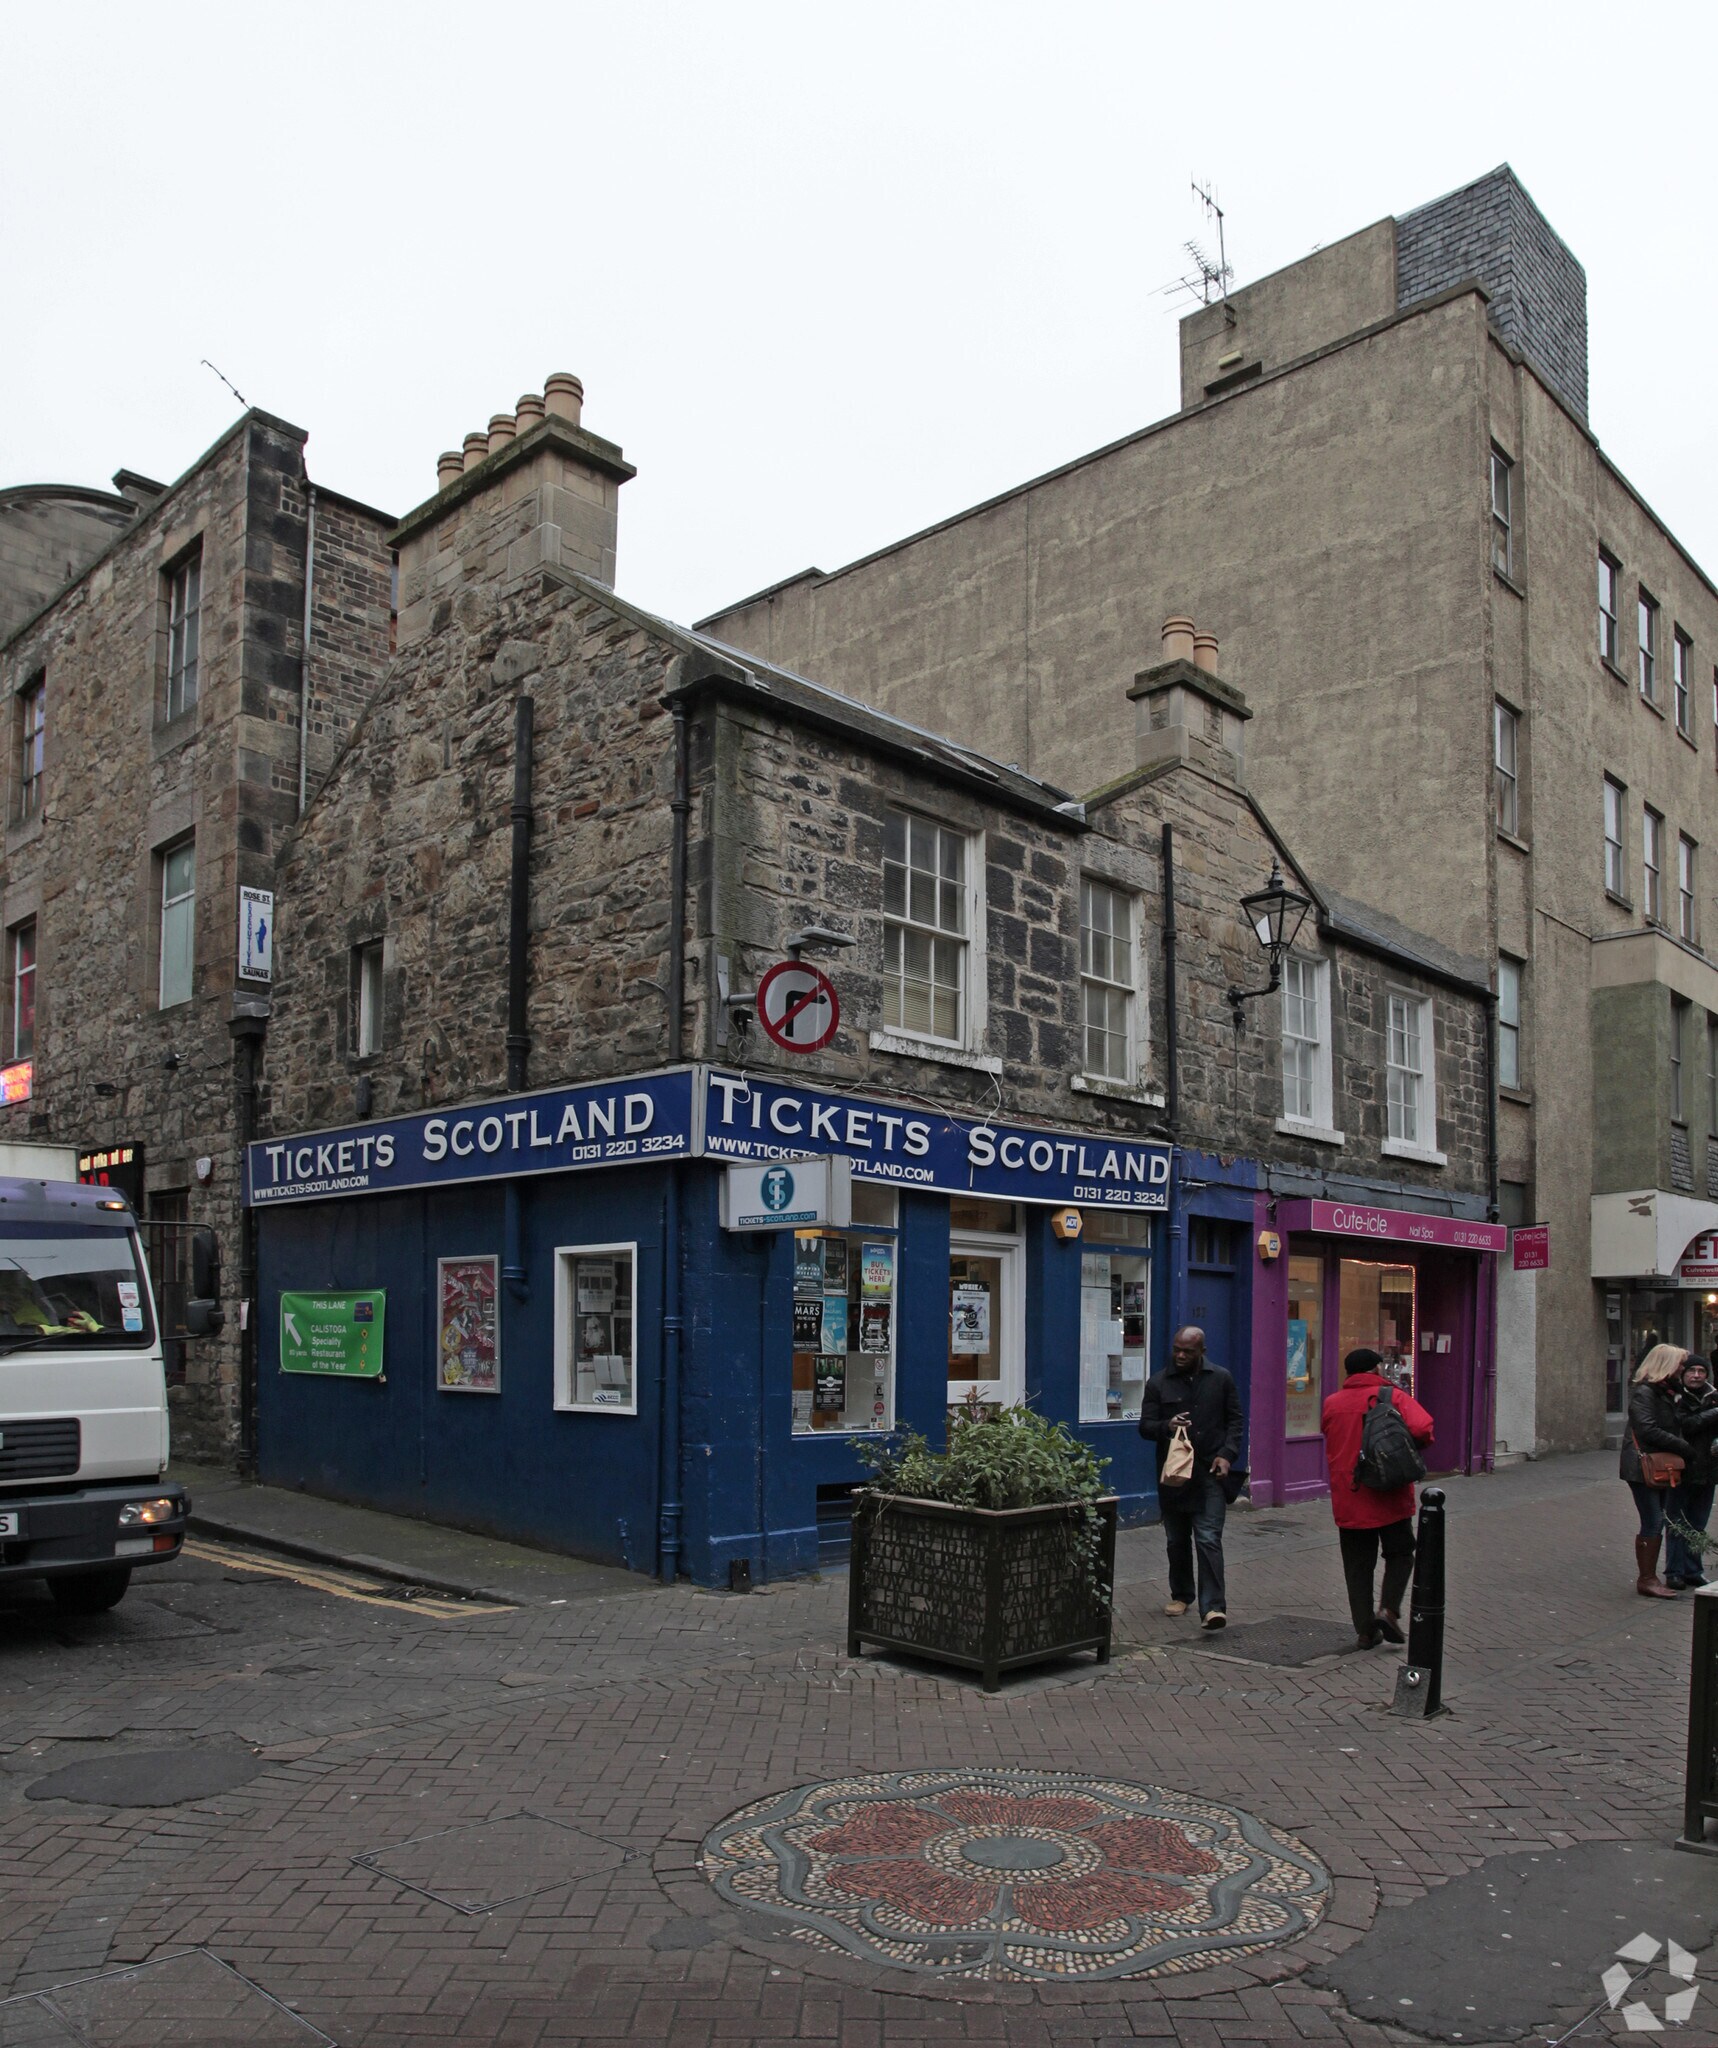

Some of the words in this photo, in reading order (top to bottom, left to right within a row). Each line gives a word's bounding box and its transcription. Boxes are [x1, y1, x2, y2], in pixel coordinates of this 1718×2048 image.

[243, 890, 261, 901] ROSE
[243, 968, 269, 979] SAUNAS
[710, 1073, 931, 1156] TICKETS
[422, 1092, 655, 1162] SCOTLAND
[573, 1145, 601, 1160] 0131
[605, 1139, 637, 1157] 220
[642, 1134, 684, 1152] 3234
[265, 1134, 396, 1182] TICKETS
[967, 1126, 1169, 1184] SCOTLAND
[254, 1175, 369, 1199] WWW.TICKETS-SCOTLAND.COM
[1073, 1186, 1102, 1200] 0131
[1105, 1188, 1131, 1202] 220
[1133, 1191, 1165, 1205] 3234
[1332, 1208, 1388, 1234] Cute-icle
[1409, 1226, 1421, 1238] Nail
[1421, 1226, 1434, 1240] Spa
[1454, 1231, 1467, 1243] 0131
[1468, 1233, 1478, 1244] 220
[1479, 1235, 1492, 1246] 6633
[1523, 1251, 1538, 1259] 0131
[870, 1261, 885, 1269] BUY
[864, 1268, 891, 1276] TICKETS
[868, 1275, 885, 1283] HERE
[312, 1301, 327, 1309] THIS
[328, 1301, 346, 1309] LANE
[794, 1306, 820, 1316] MARS
[311, 1325, 347, 1334] CALISTOGA
[311, 1349, 346, 1358] Restaurant
[319, 1361, 330, 1370] the
[330, 1362, 347, 1371] Year
